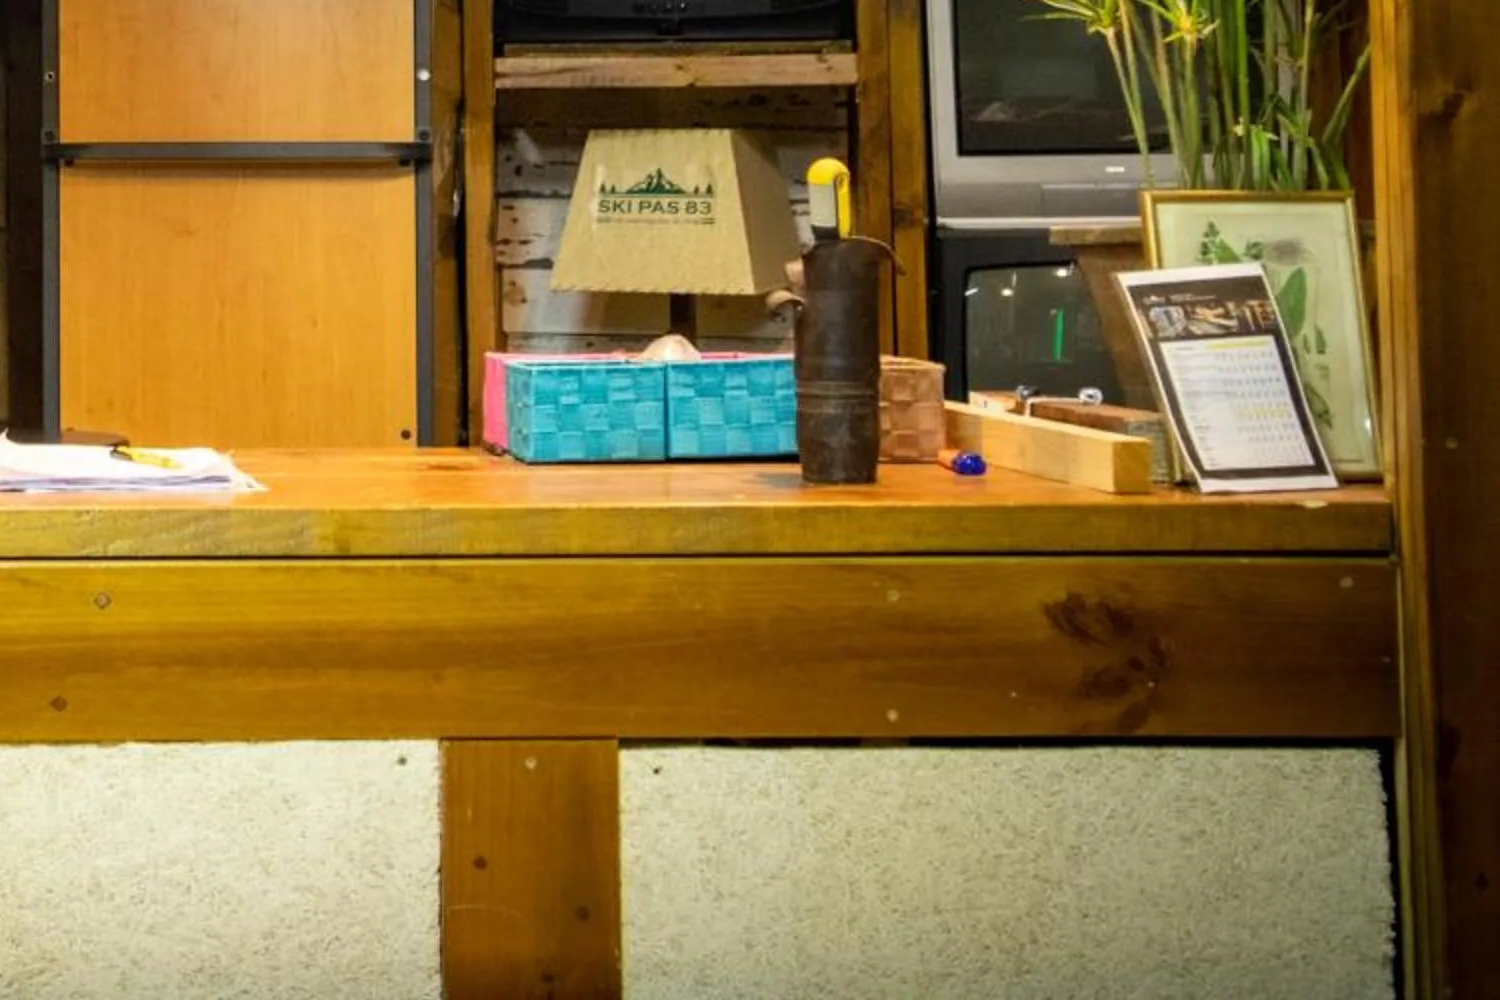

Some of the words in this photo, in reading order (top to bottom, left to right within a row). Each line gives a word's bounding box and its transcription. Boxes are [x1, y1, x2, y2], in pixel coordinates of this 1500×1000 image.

[598, 199, 632, 213] SKI
[638, 200, 680, 215] PAS
[685, 201, 712, 215] 83
